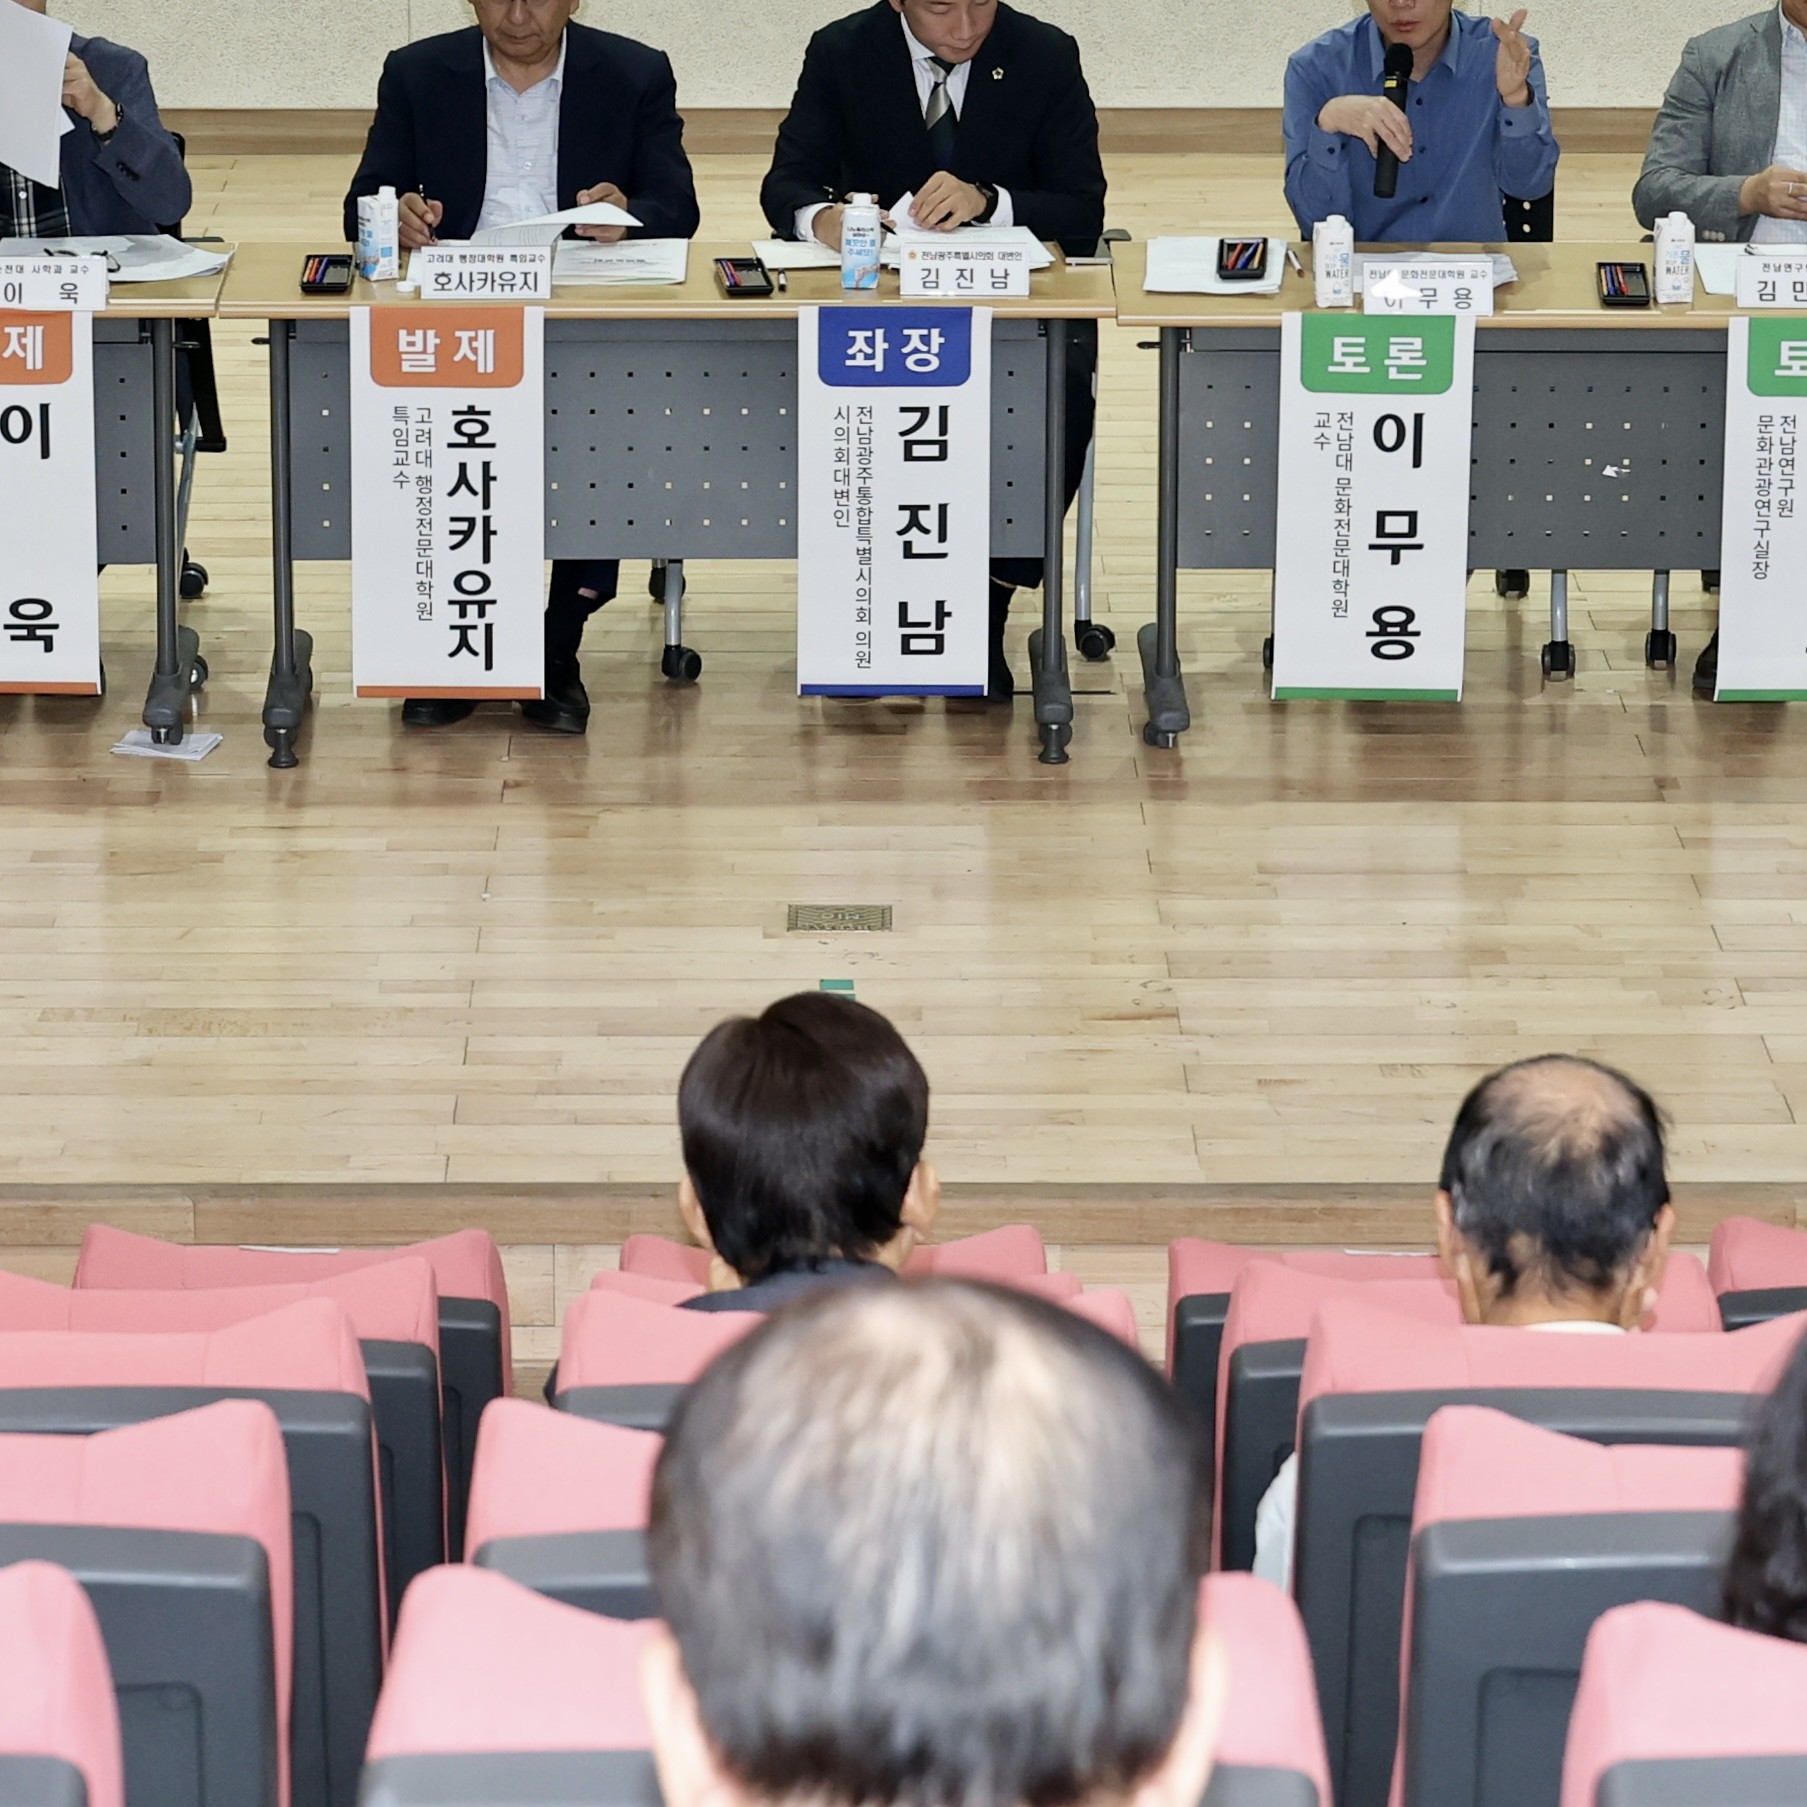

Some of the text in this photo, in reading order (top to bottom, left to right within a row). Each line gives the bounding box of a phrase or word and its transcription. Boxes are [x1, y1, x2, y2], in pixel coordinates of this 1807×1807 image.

[32, 265, 62, 274] 사학과
[70, 265, 89, 274] 교수
[427, 254, 545, 263] 고려대 행정대학원 특임교수
[922, 251, 1022, 261] 전남광주특별시의회 대변인
[1325, 268, 1349, 279] WATER
[1401, 270, 1464, 279] 문화전문대학원
[1471, 270, 1487, 279] 교수
[1665, 265, 1689, 275] WATER
[434, 272, 537, 292] 호사카유지
[399, 330, 494, 373] 발제
[845, 328, 945, 372] 좌장
[1328, 337, 1427, 379] 토론
[392, 406, 410, 489] 특임교수
[1313, 412, 1331, 451] 교수
[834, 405, 850, 528] 시의회대변인
[1777, 415, 1797, 518] 전남연구원
[415, 407, 433, 621] 고려대 행정전문대학원
[1331, 411, 1354, 618] 전남대 문화전문대학원
[1752, 415, 1775, 580] 문화관광연구실장
[855, 405, 873, 669] 전남광주통합특별시의회 의원
